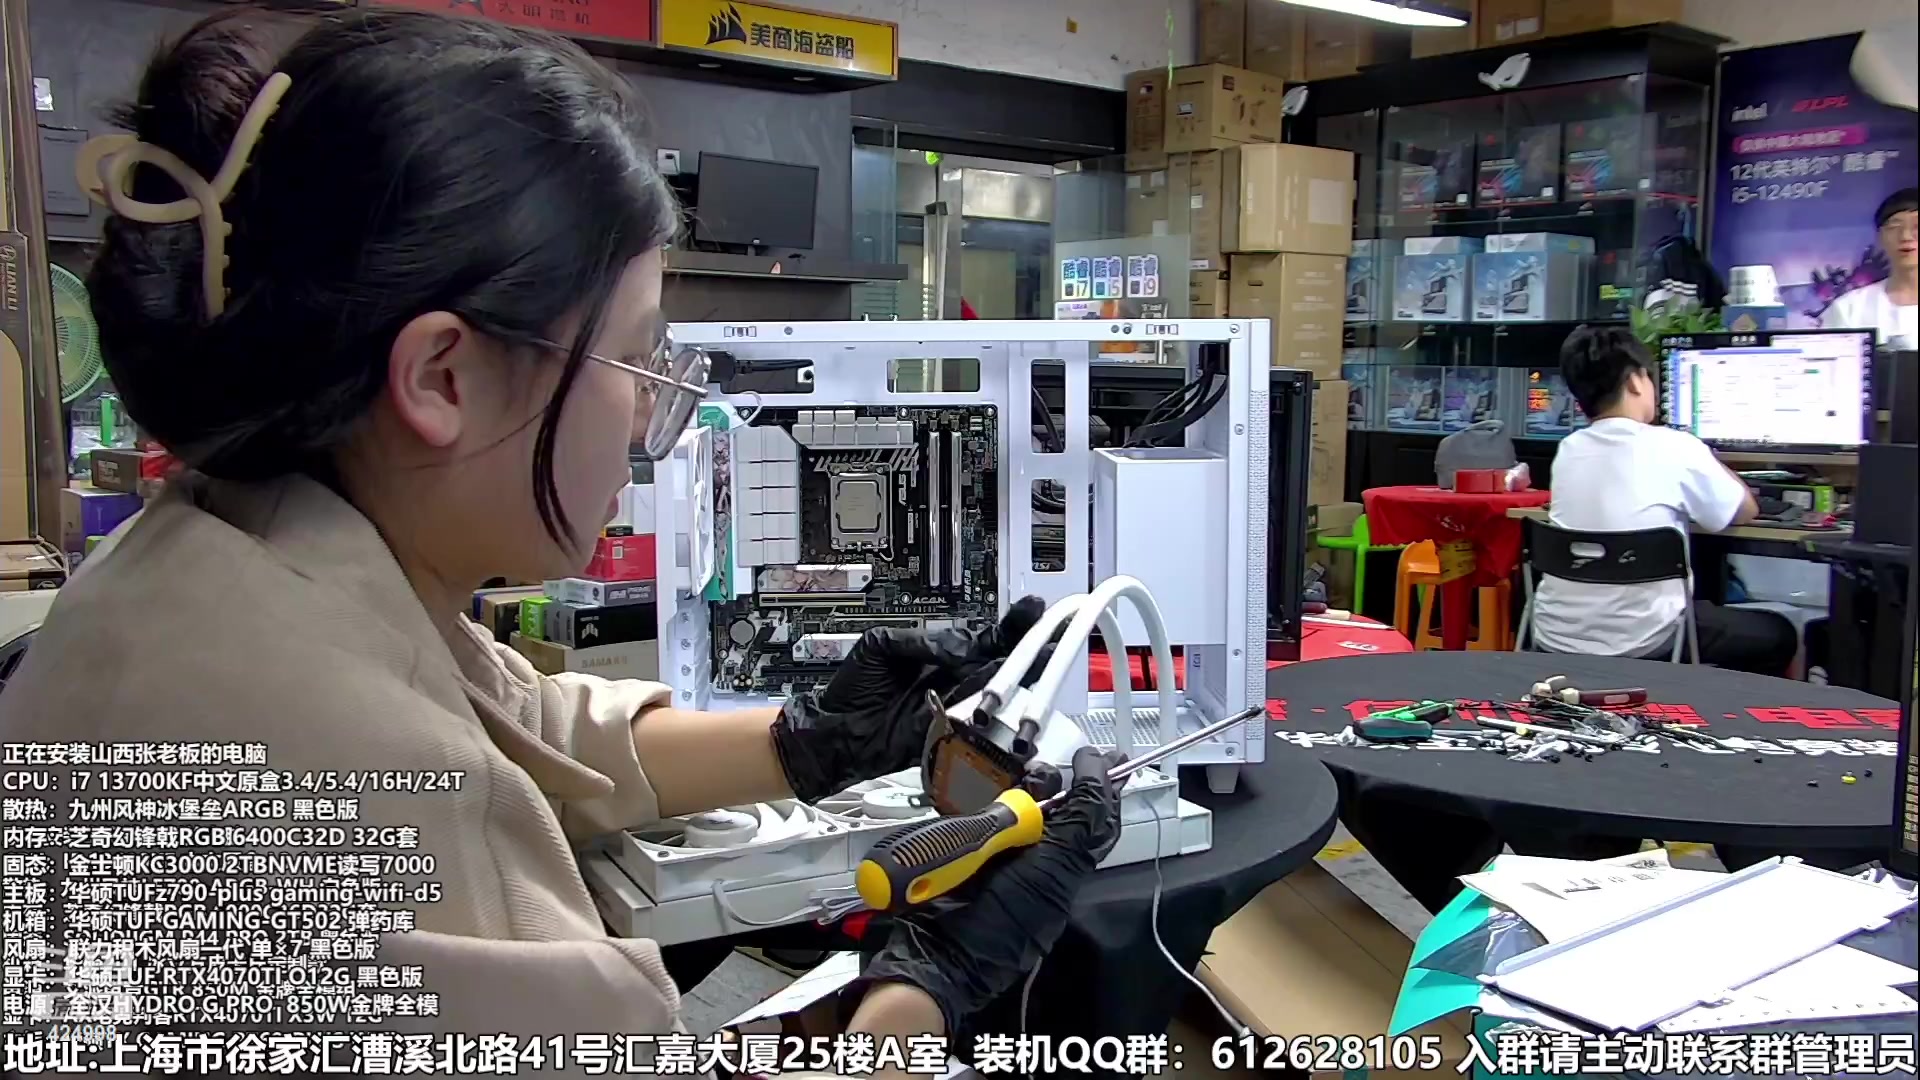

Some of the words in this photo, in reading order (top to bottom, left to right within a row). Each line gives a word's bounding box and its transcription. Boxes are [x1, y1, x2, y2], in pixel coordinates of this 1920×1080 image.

[750, 22, 855, 60] 美商海盗船
[1731, 102, 1767, 122] intel
[1731, 180, 1829, 204] i5-12490F
[1076, 280, 1089, 297] i7
[1108, 278, 1121, 296] i5
[1143, 278, 1157, 296] i9
